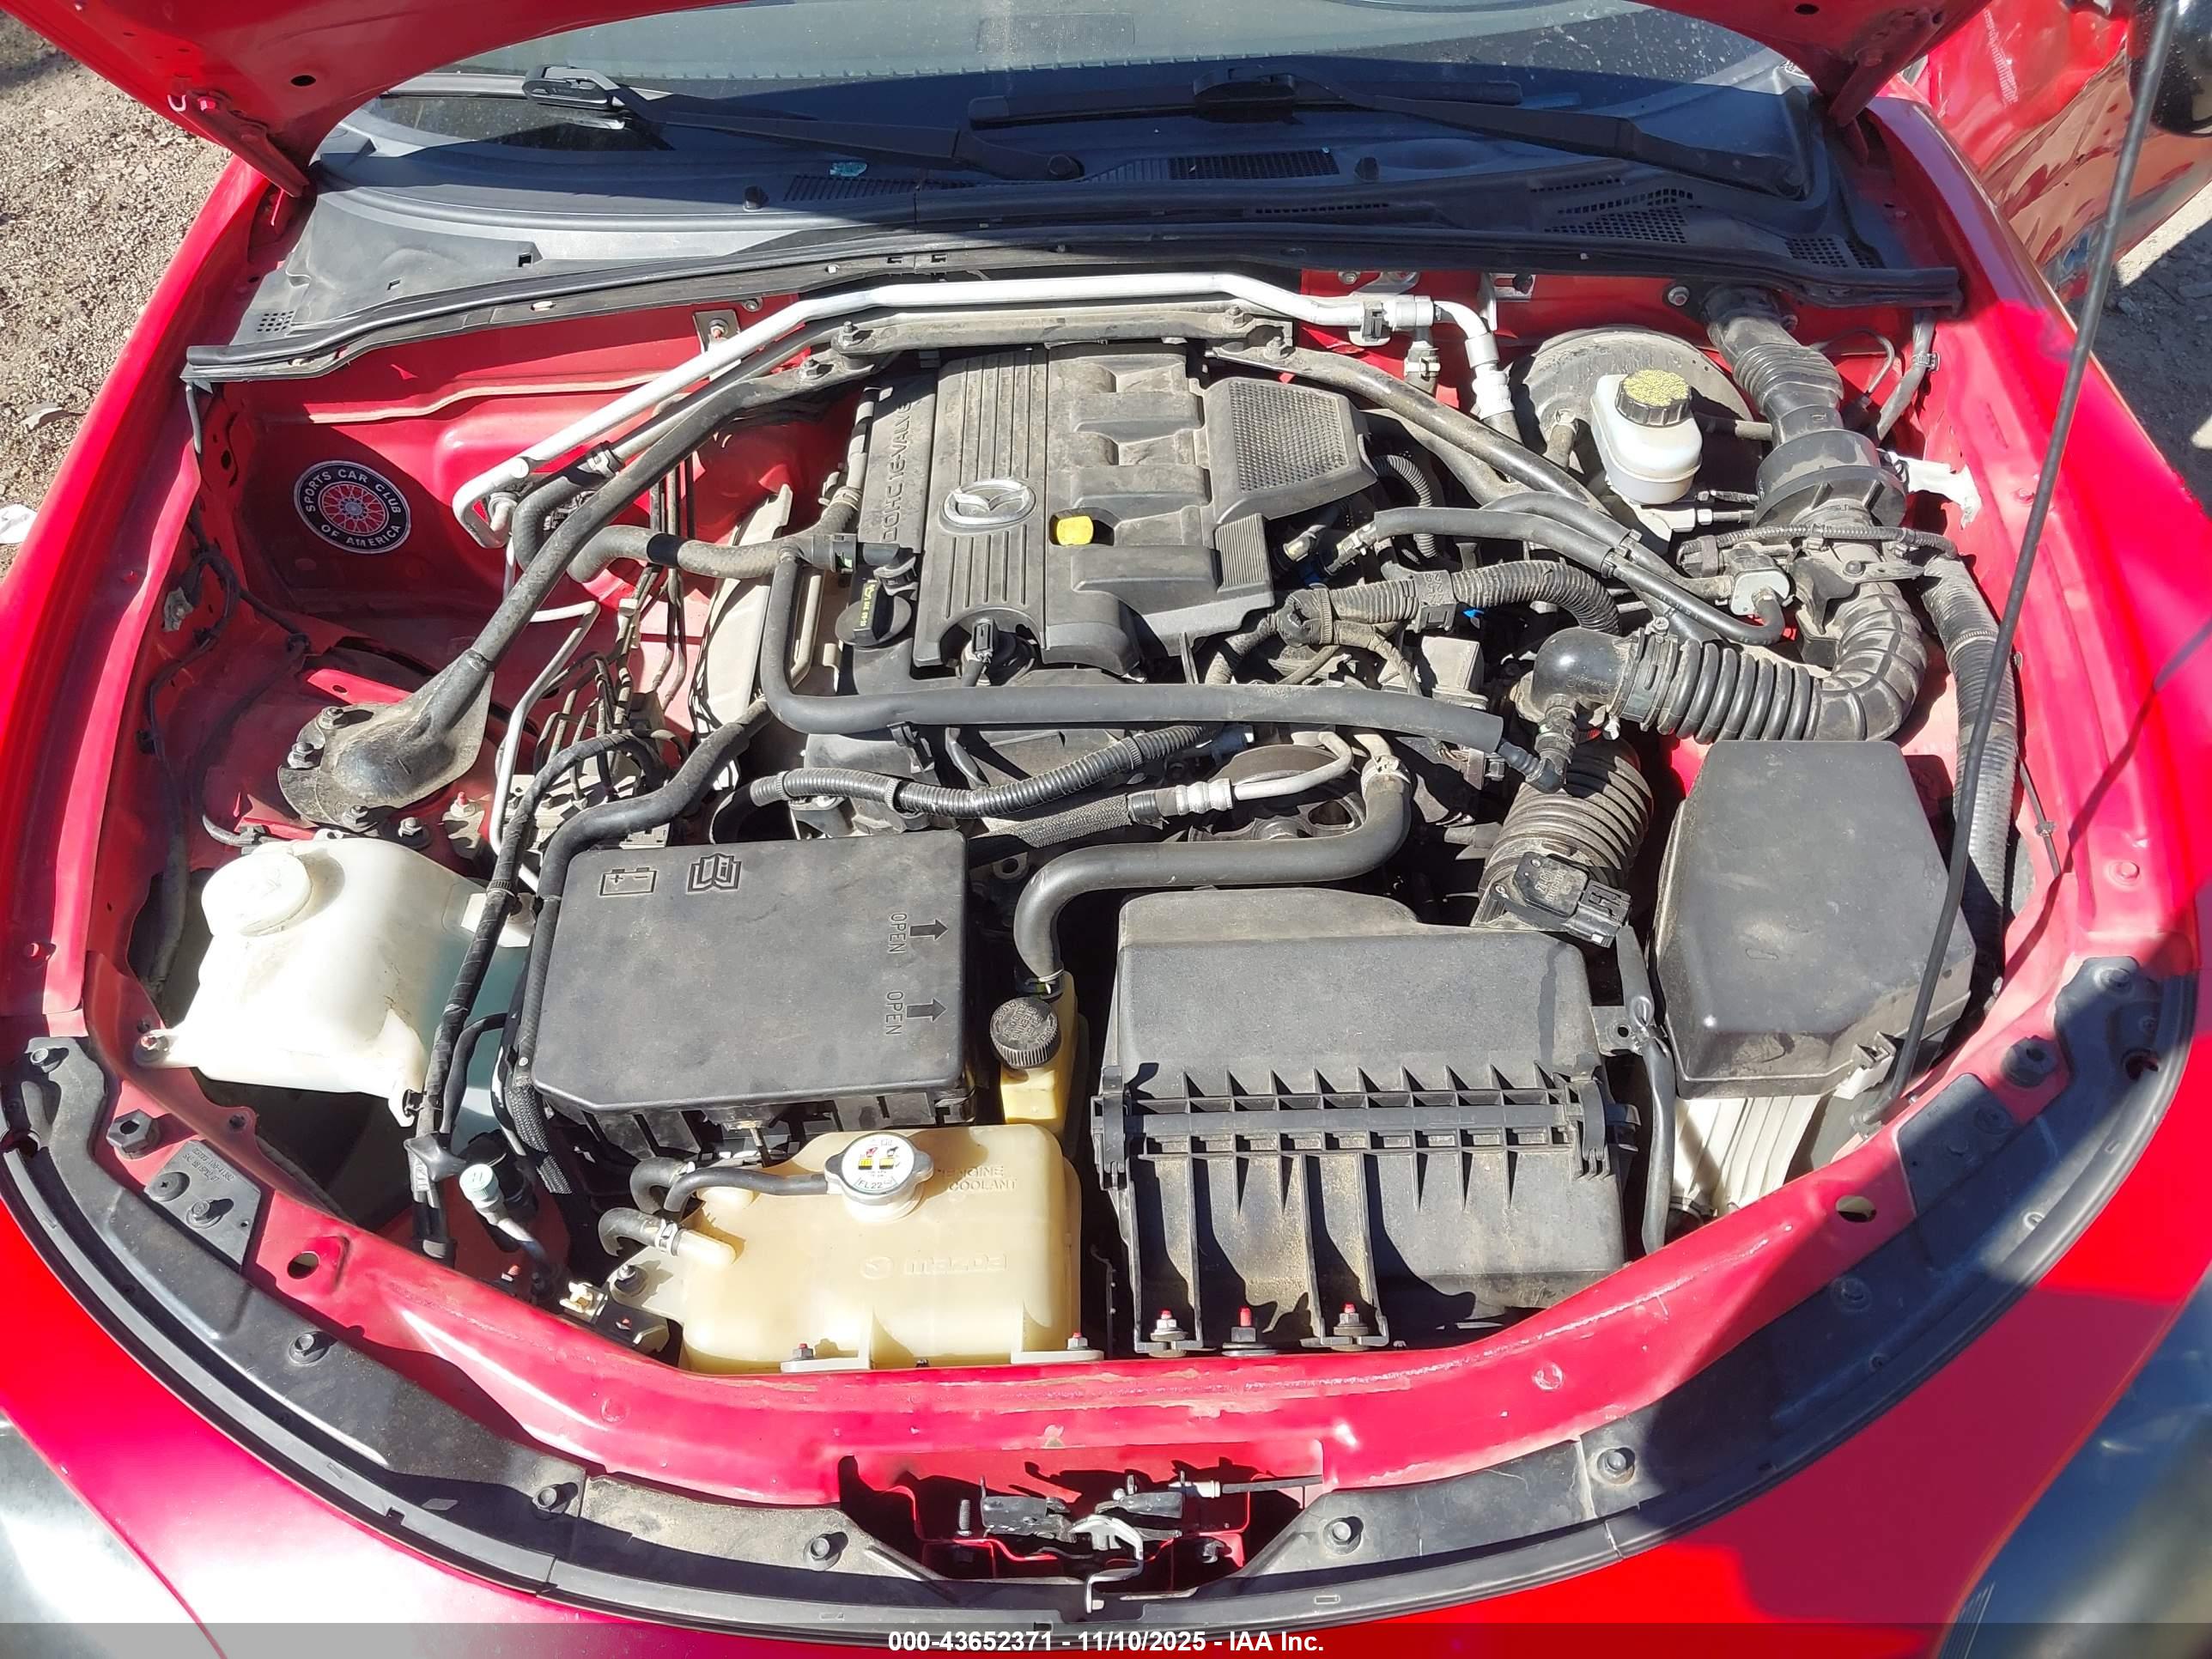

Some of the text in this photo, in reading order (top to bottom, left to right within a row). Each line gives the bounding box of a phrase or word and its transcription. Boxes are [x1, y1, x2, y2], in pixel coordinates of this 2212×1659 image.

[304, 468, 401, 514] SPORTS CAR CLUB
[882, 482, 902, 543] DOHC
[321, 524, 401, 547] OF AMERICA
[889, 913, 908, 953] OPEN
[886, 991, 903, 1035] OPEN
[1012, 1007, 1037, 1040] STEERING
[859, 1180, 883, 1188] FL22
[942, 1166, 1004, 1176] ENGINE
[949, 1178, 1017, 1190] COOLANT
